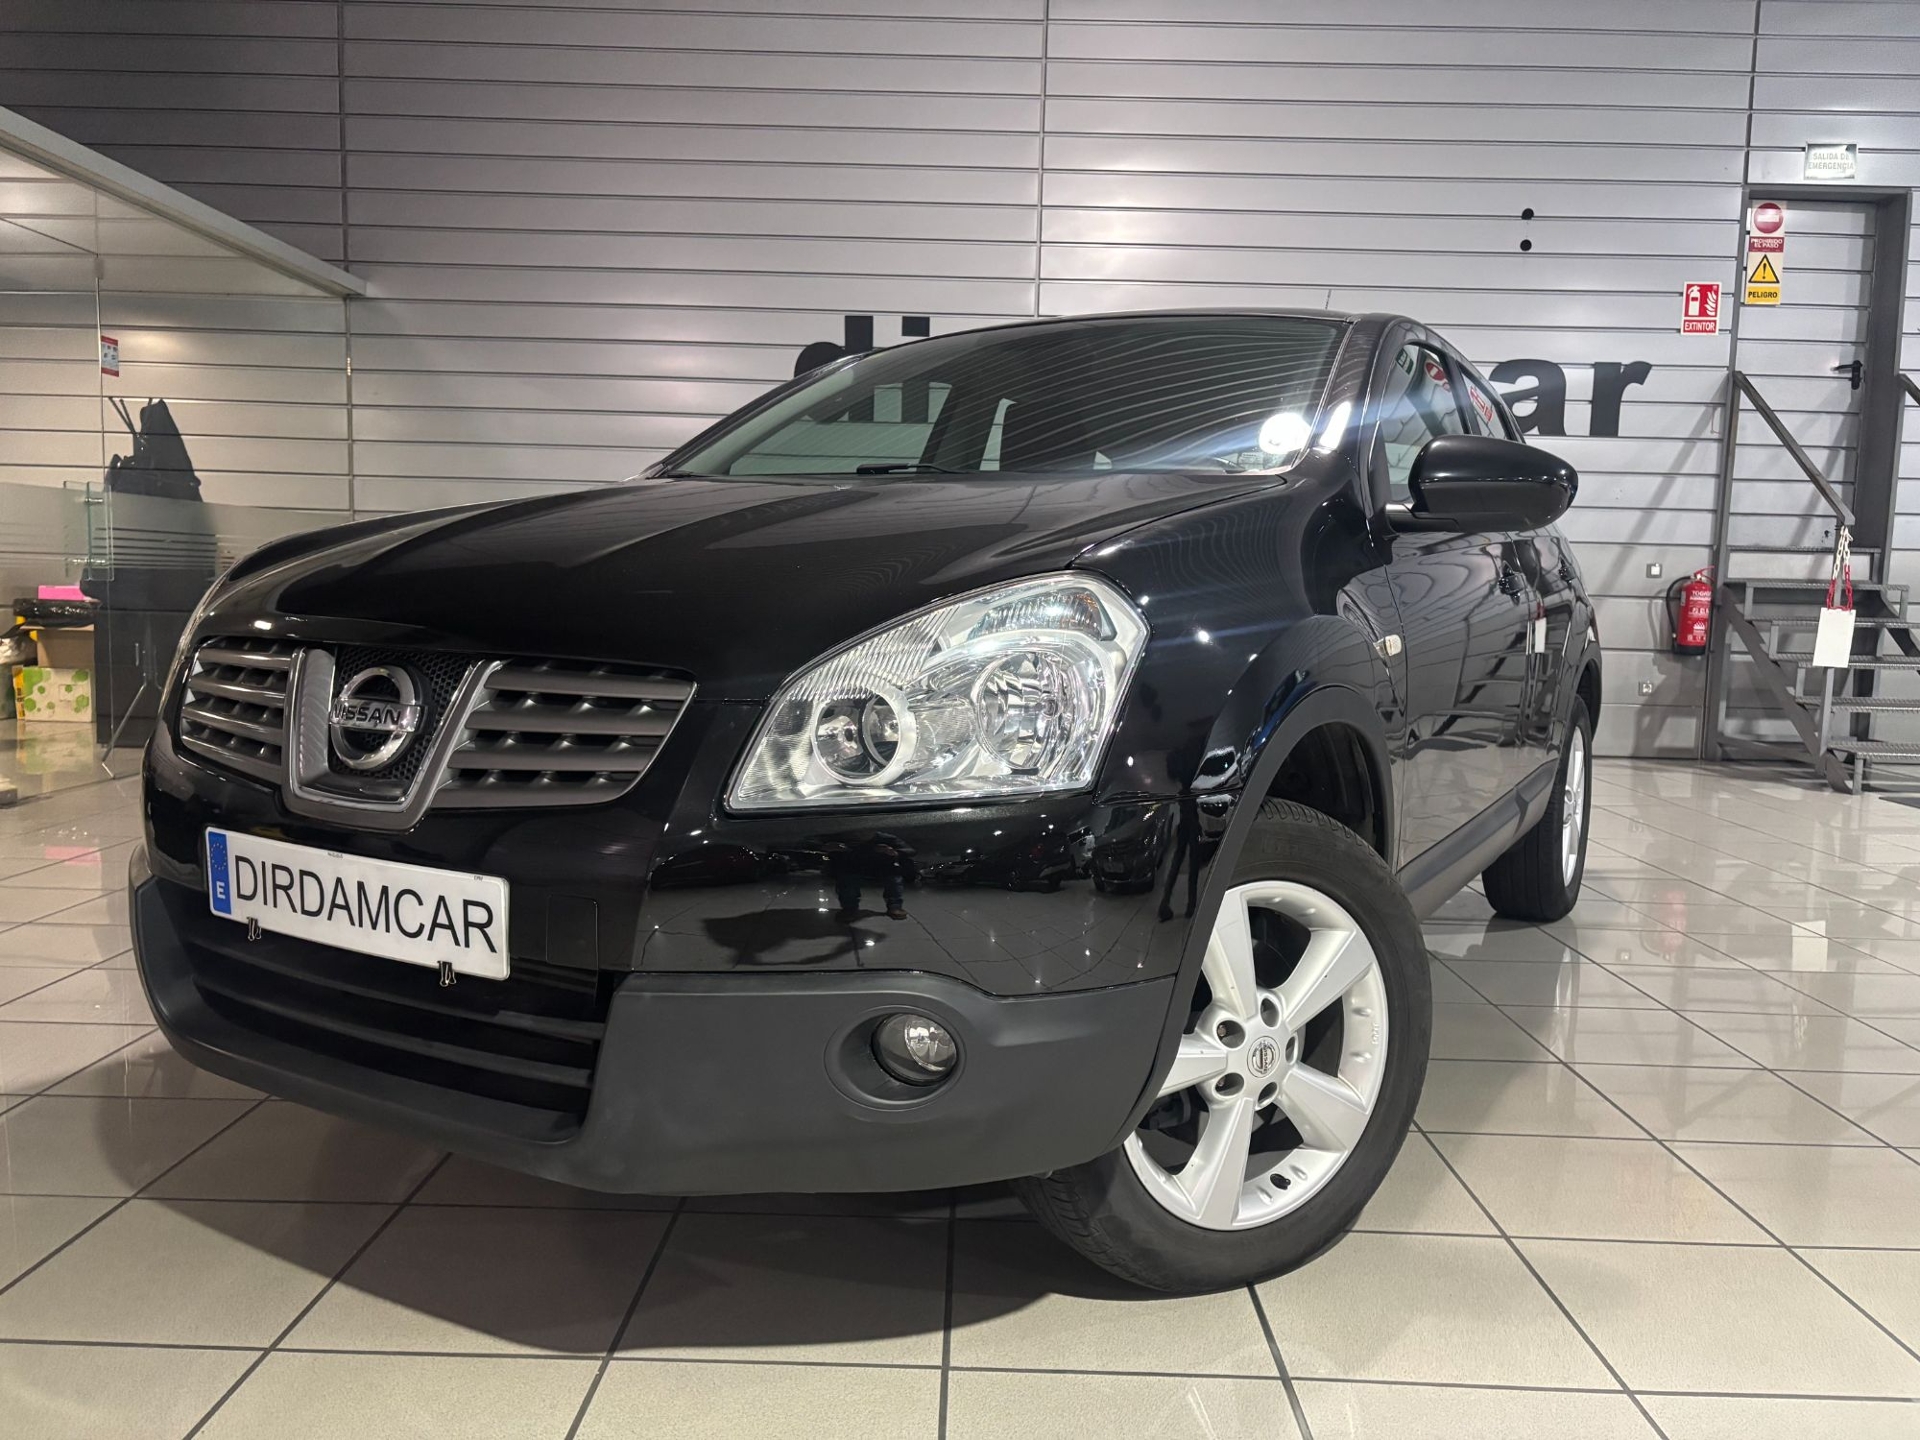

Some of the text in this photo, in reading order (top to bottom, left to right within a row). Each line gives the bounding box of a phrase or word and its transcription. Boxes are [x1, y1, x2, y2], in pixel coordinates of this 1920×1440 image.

[1813, 152, 1838, 161] SALIDA
[1808, 162, 1854, 170] EMERGENCIA
[1748, 291, 1778, 299] PELIGRO
[1684, 322, 1715, 331] EXTINTOR
[332, 703, 401, 726] NISSAN
[216, 855, 498, 953] E DIRDAMCAR
